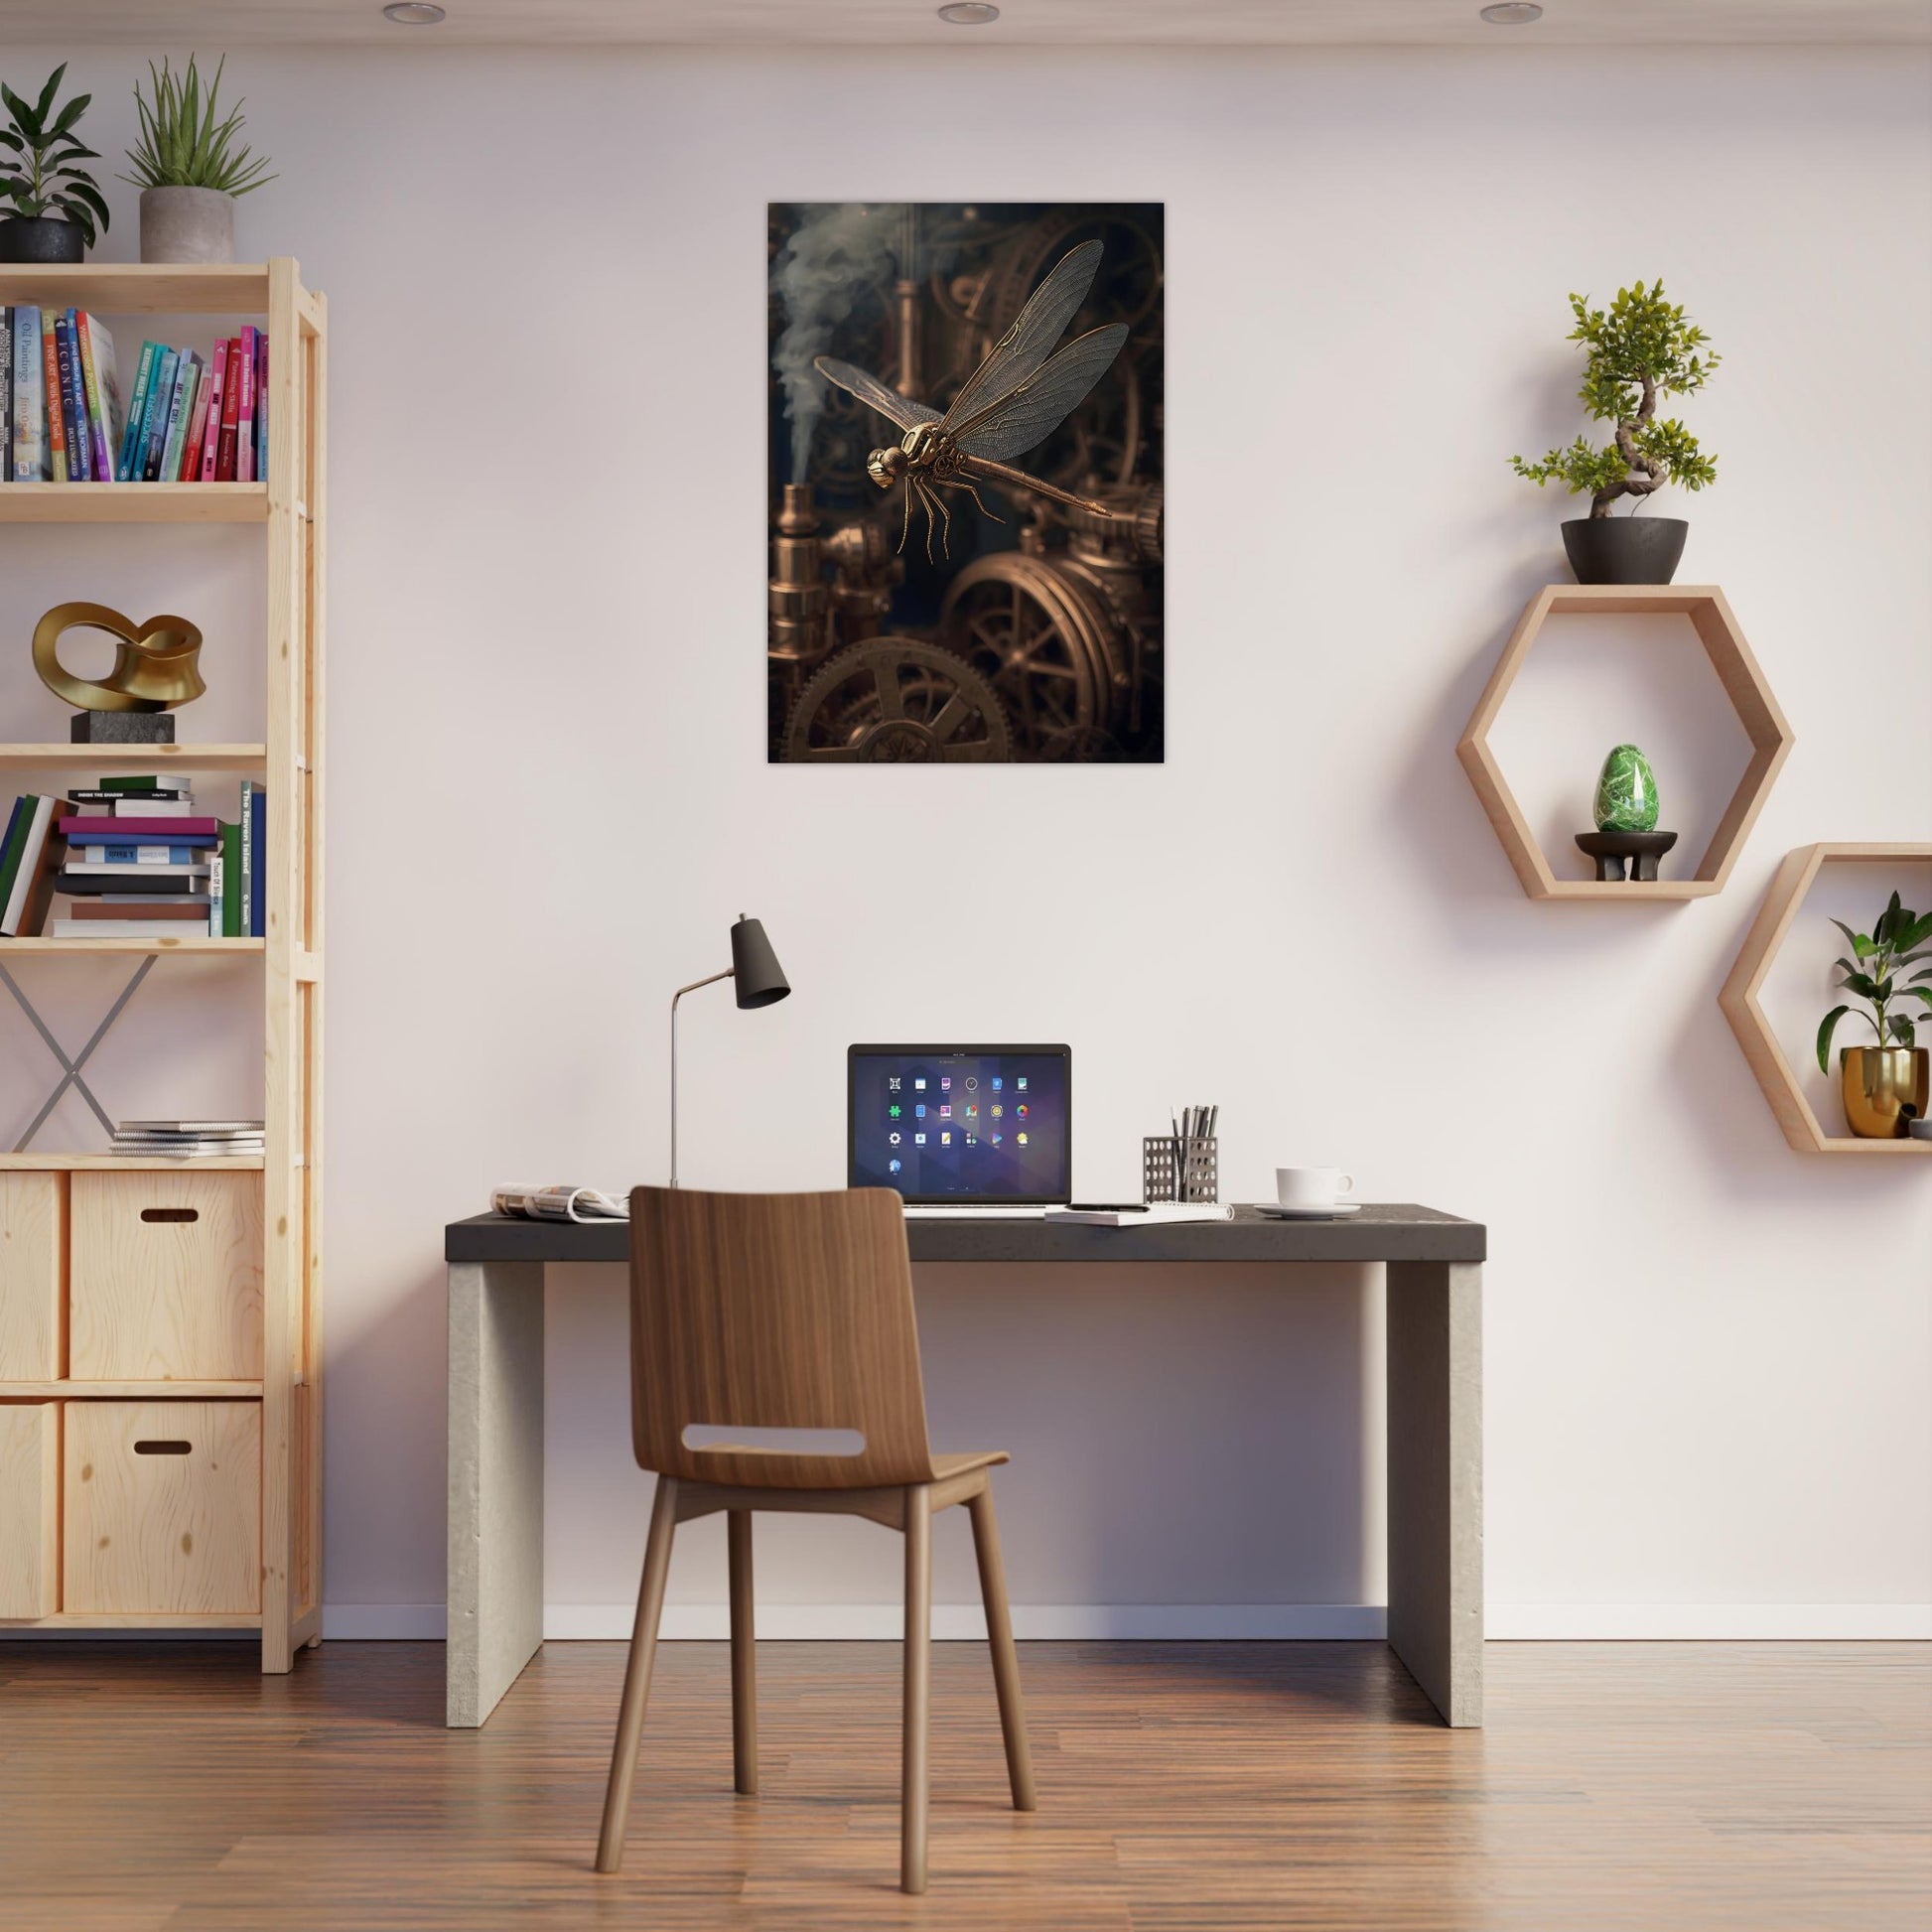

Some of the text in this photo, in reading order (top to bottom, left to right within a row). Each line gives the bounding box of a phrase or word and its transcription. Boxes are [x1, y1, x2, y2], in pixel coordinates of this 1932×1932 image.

[22, 323, 32, 337] Oil
[18, 340, 32, 383] Paintings
[59, 342, 72, 405] ICONIC
